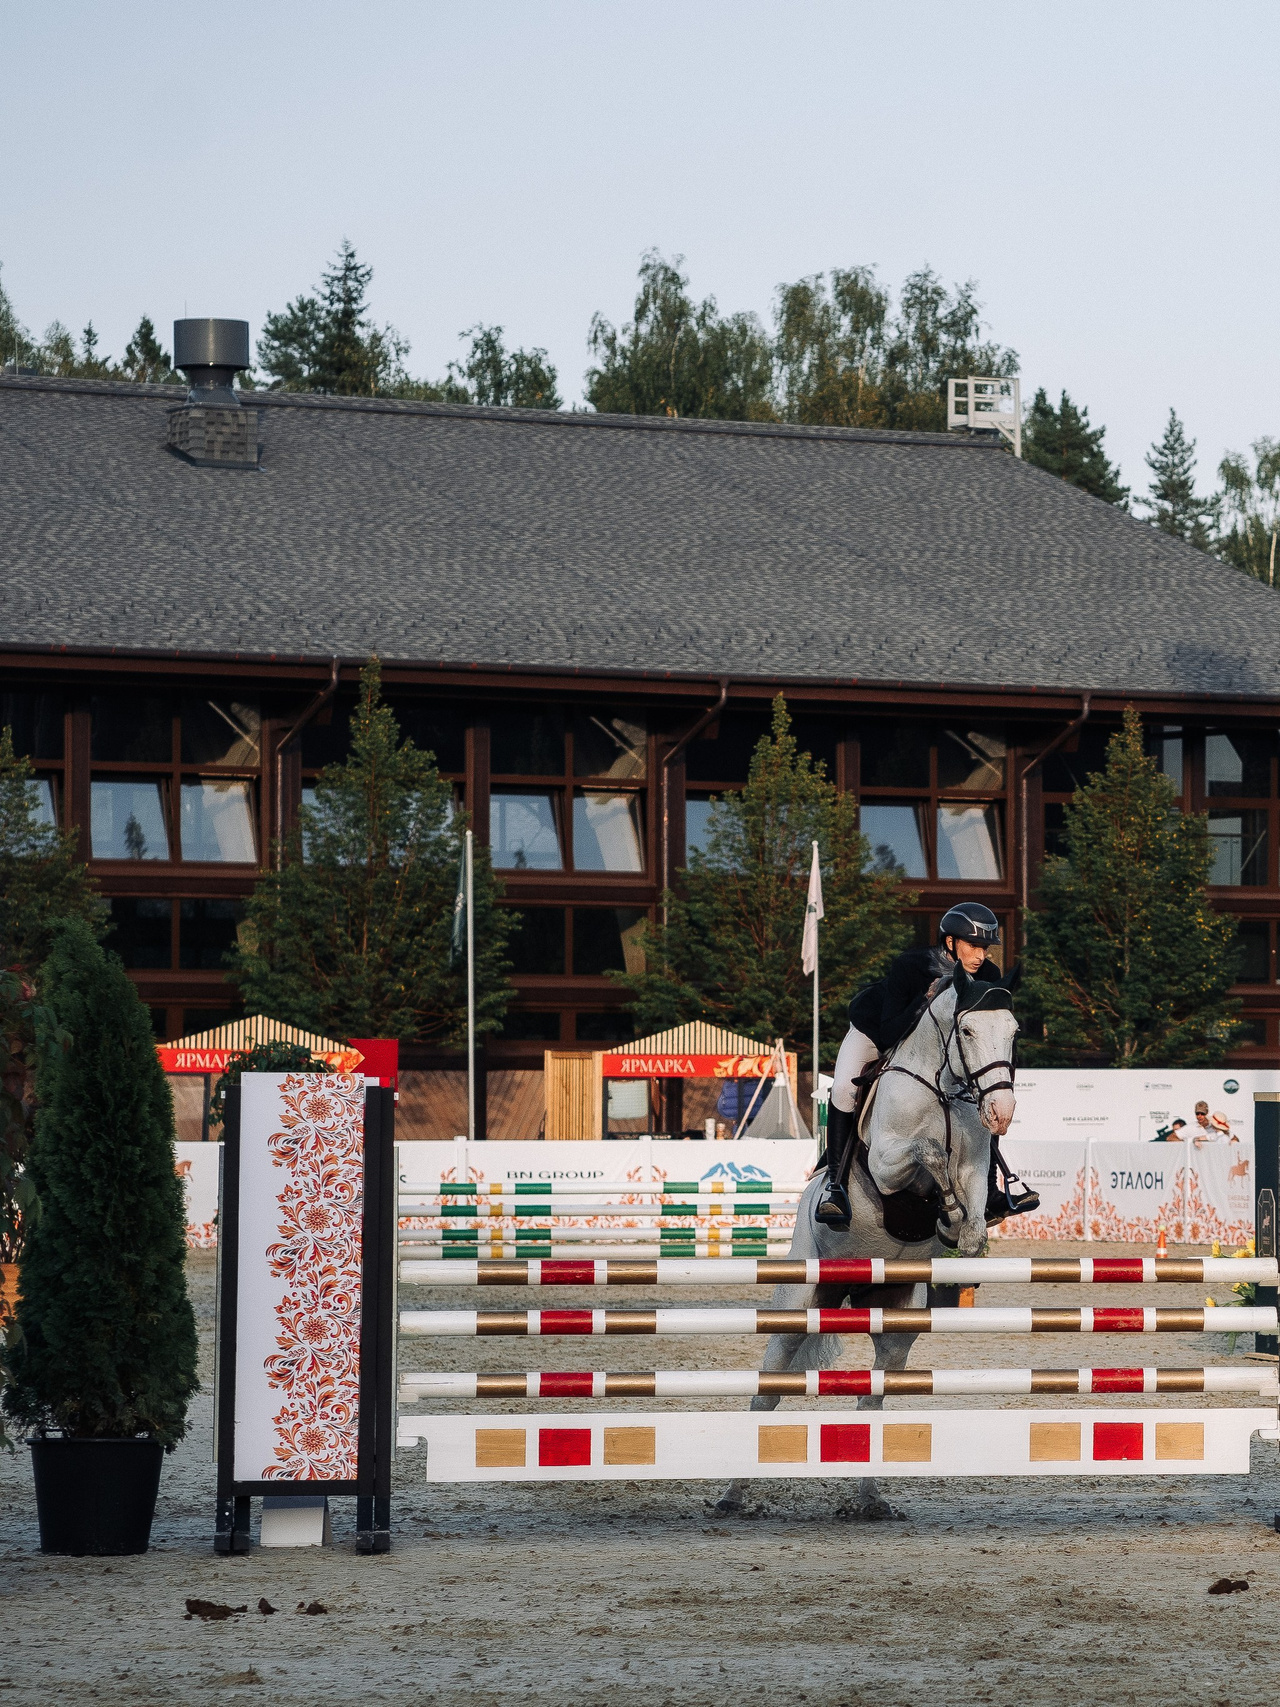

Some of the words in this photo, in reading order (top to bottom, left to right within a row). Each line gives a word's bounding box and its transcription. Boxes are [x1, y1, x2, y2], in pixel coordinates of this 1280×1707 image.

[620, 1058, 696, 1074] ЯРМАРКА
[506, 1170, 532, 1179] BN
[538, 1170, 605, 1179] GROUP
[1032, 1169, 1066, 1178] GROUP
[1111, 1171, 1164, 1190] ЭТАЛОН
